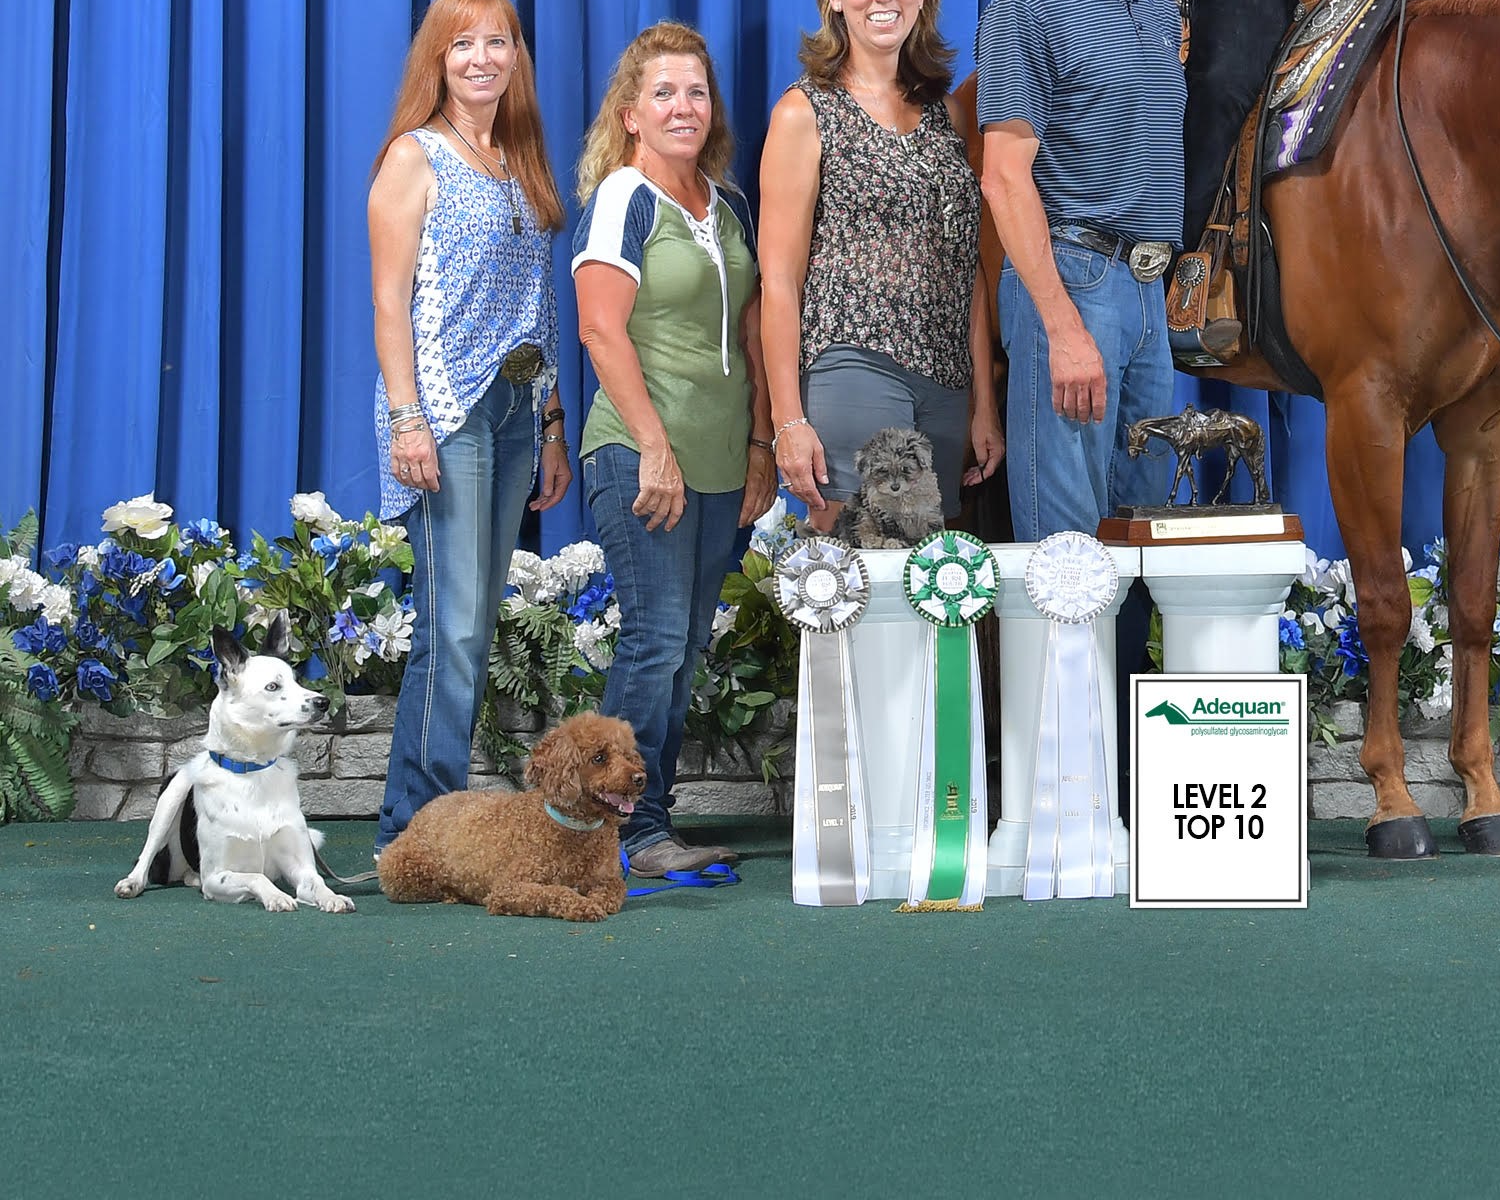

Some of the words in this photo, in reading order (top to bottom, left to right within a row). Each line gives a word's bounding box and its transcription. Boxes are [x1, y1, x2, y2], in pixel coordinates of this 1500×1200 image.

[1173, 783, 1245, 808] LEVEL
[1251, 783, 1267, 808] 2
[1174, 815, 1225, 839] TOP
[1235, 815, 1264, 839] 10
